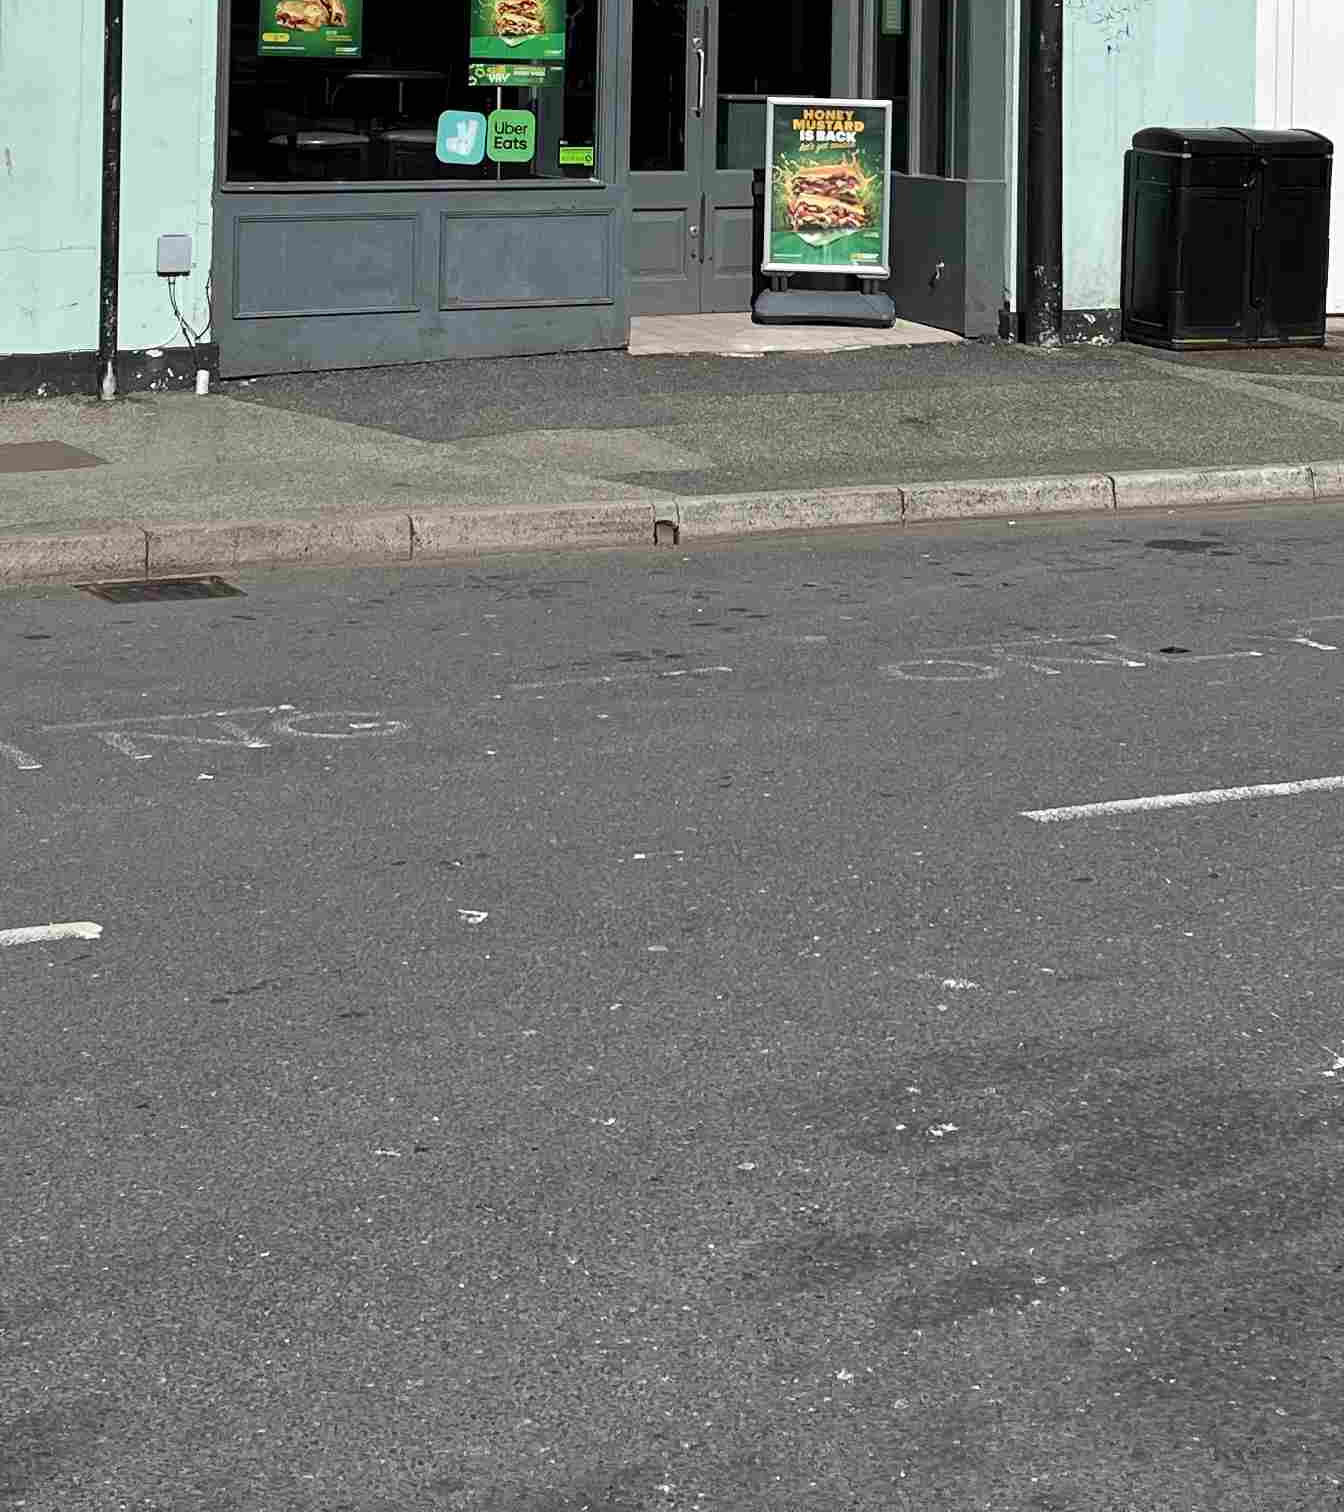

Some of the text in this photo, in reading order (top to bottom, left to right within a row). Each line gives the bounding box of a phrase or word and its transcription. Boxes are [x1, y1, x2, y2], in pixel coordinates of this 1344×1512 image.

[803, 109, 855, 121] HONEY
[494, 120, 528, 135] Uber
[792, 120, 865, 132] MUSTARD
[800, 130, 857, 143] IS BACK
[494, 137, 528, 150] Eats
